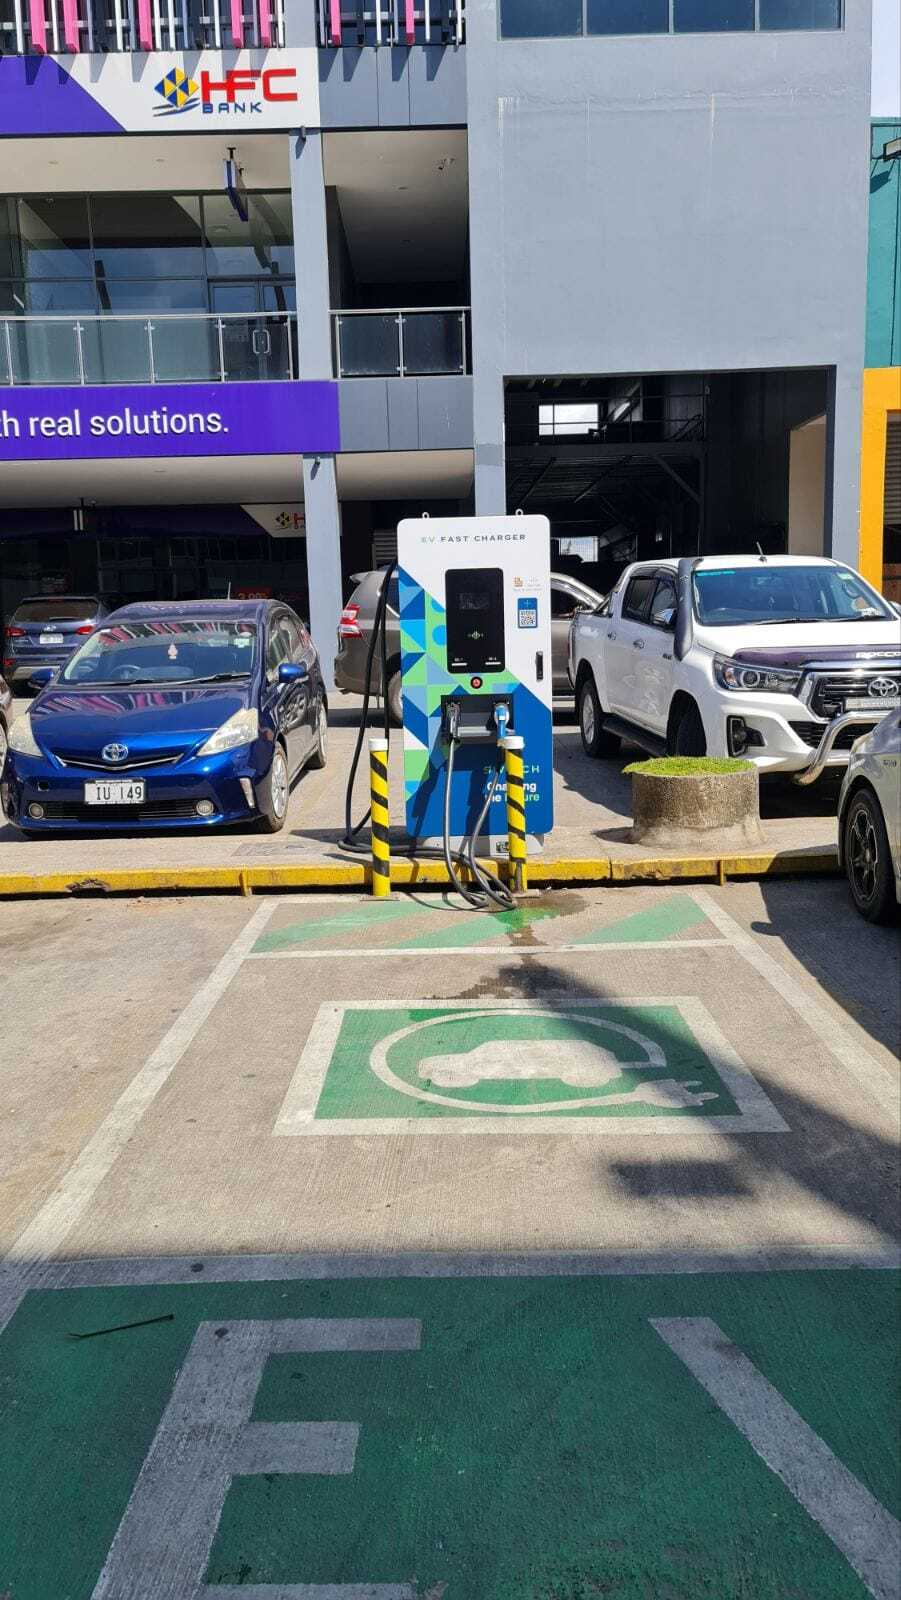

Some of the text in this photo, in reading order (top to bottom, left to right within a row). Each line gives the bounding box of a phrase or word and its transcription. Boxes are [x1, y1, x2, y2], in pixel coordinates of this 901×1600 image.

[201, 68, 298, 103] HFC
[202, 102, 262, 114] BANK
[29, 409, 81, 436] real
[90, 406, 229, 435] solutions.
[421, 533, 526, 544] EV FAST CHARGER
[97, 785, 143, 801] IU 149
